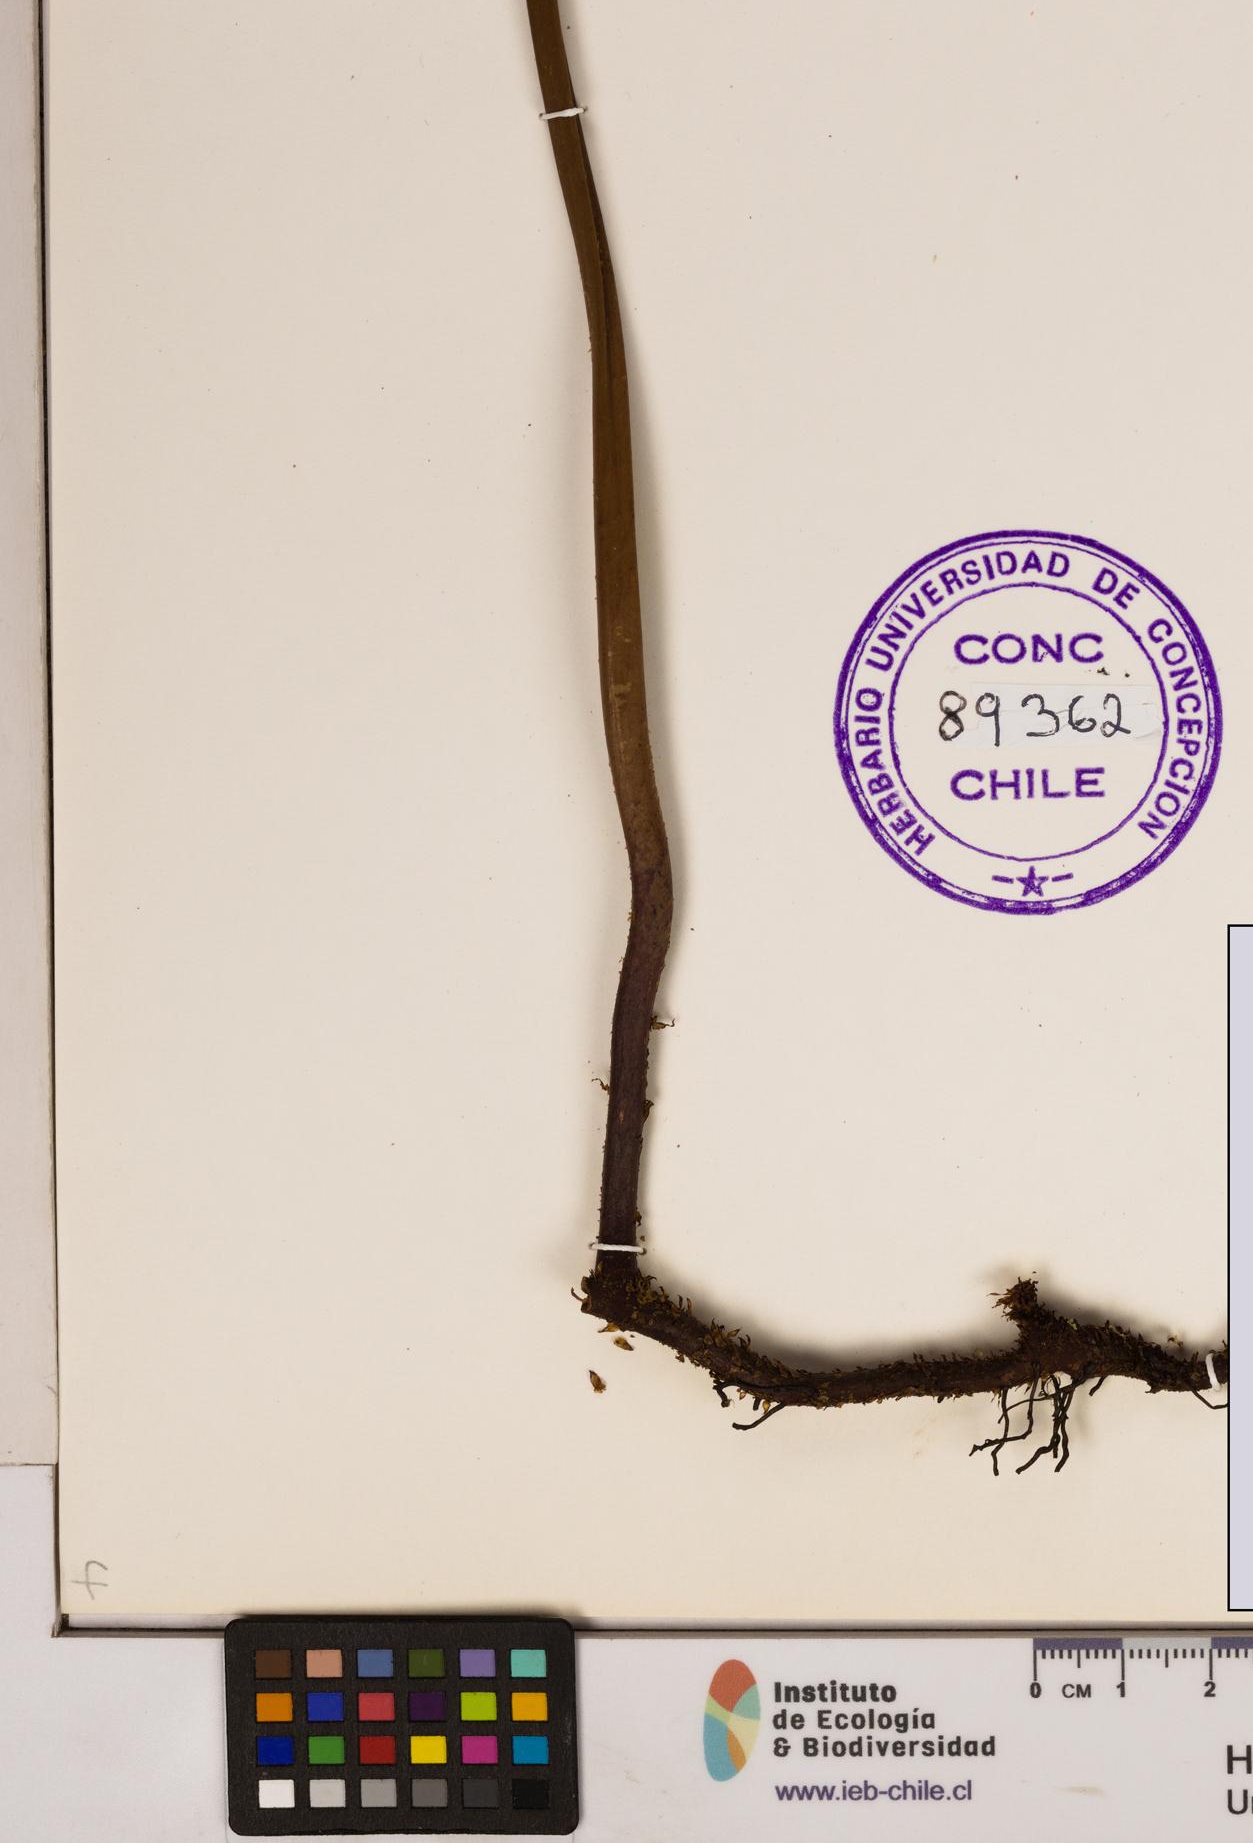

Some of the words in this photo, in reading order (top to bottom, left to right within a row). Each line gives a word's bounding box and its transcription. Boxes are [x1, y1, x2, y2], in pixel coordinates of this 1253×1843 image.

[1091, 566, 1141, 611] DE
[865, 550, 1071, 673] UNIVERSIDAD
[953, 633, 1106, 665] CONC
[1137, 617, 1204, 841] CONCEPCION
[854, 686, 937, 857] HERBARIO
[950, 767, 1107, 802] CHILE
[774, 1680, 898, 1704] Instituto
[1031, 1682, 1043, 1699] 0
[1062, 1684, 1093, 1700] CM
[1117, 1681, 1127, 1698] 1
[1204, 1681, 1218, 1699] 2
[772, 1709, 806, 1731] de
[817, 1707, 937, 1734] Ecología
[773, 1736, 792, 1758] &
[802, 1735, 997, 1758] Biodiversidad
[775, 1779, 974, 1803] www.ieb-chile.cl
